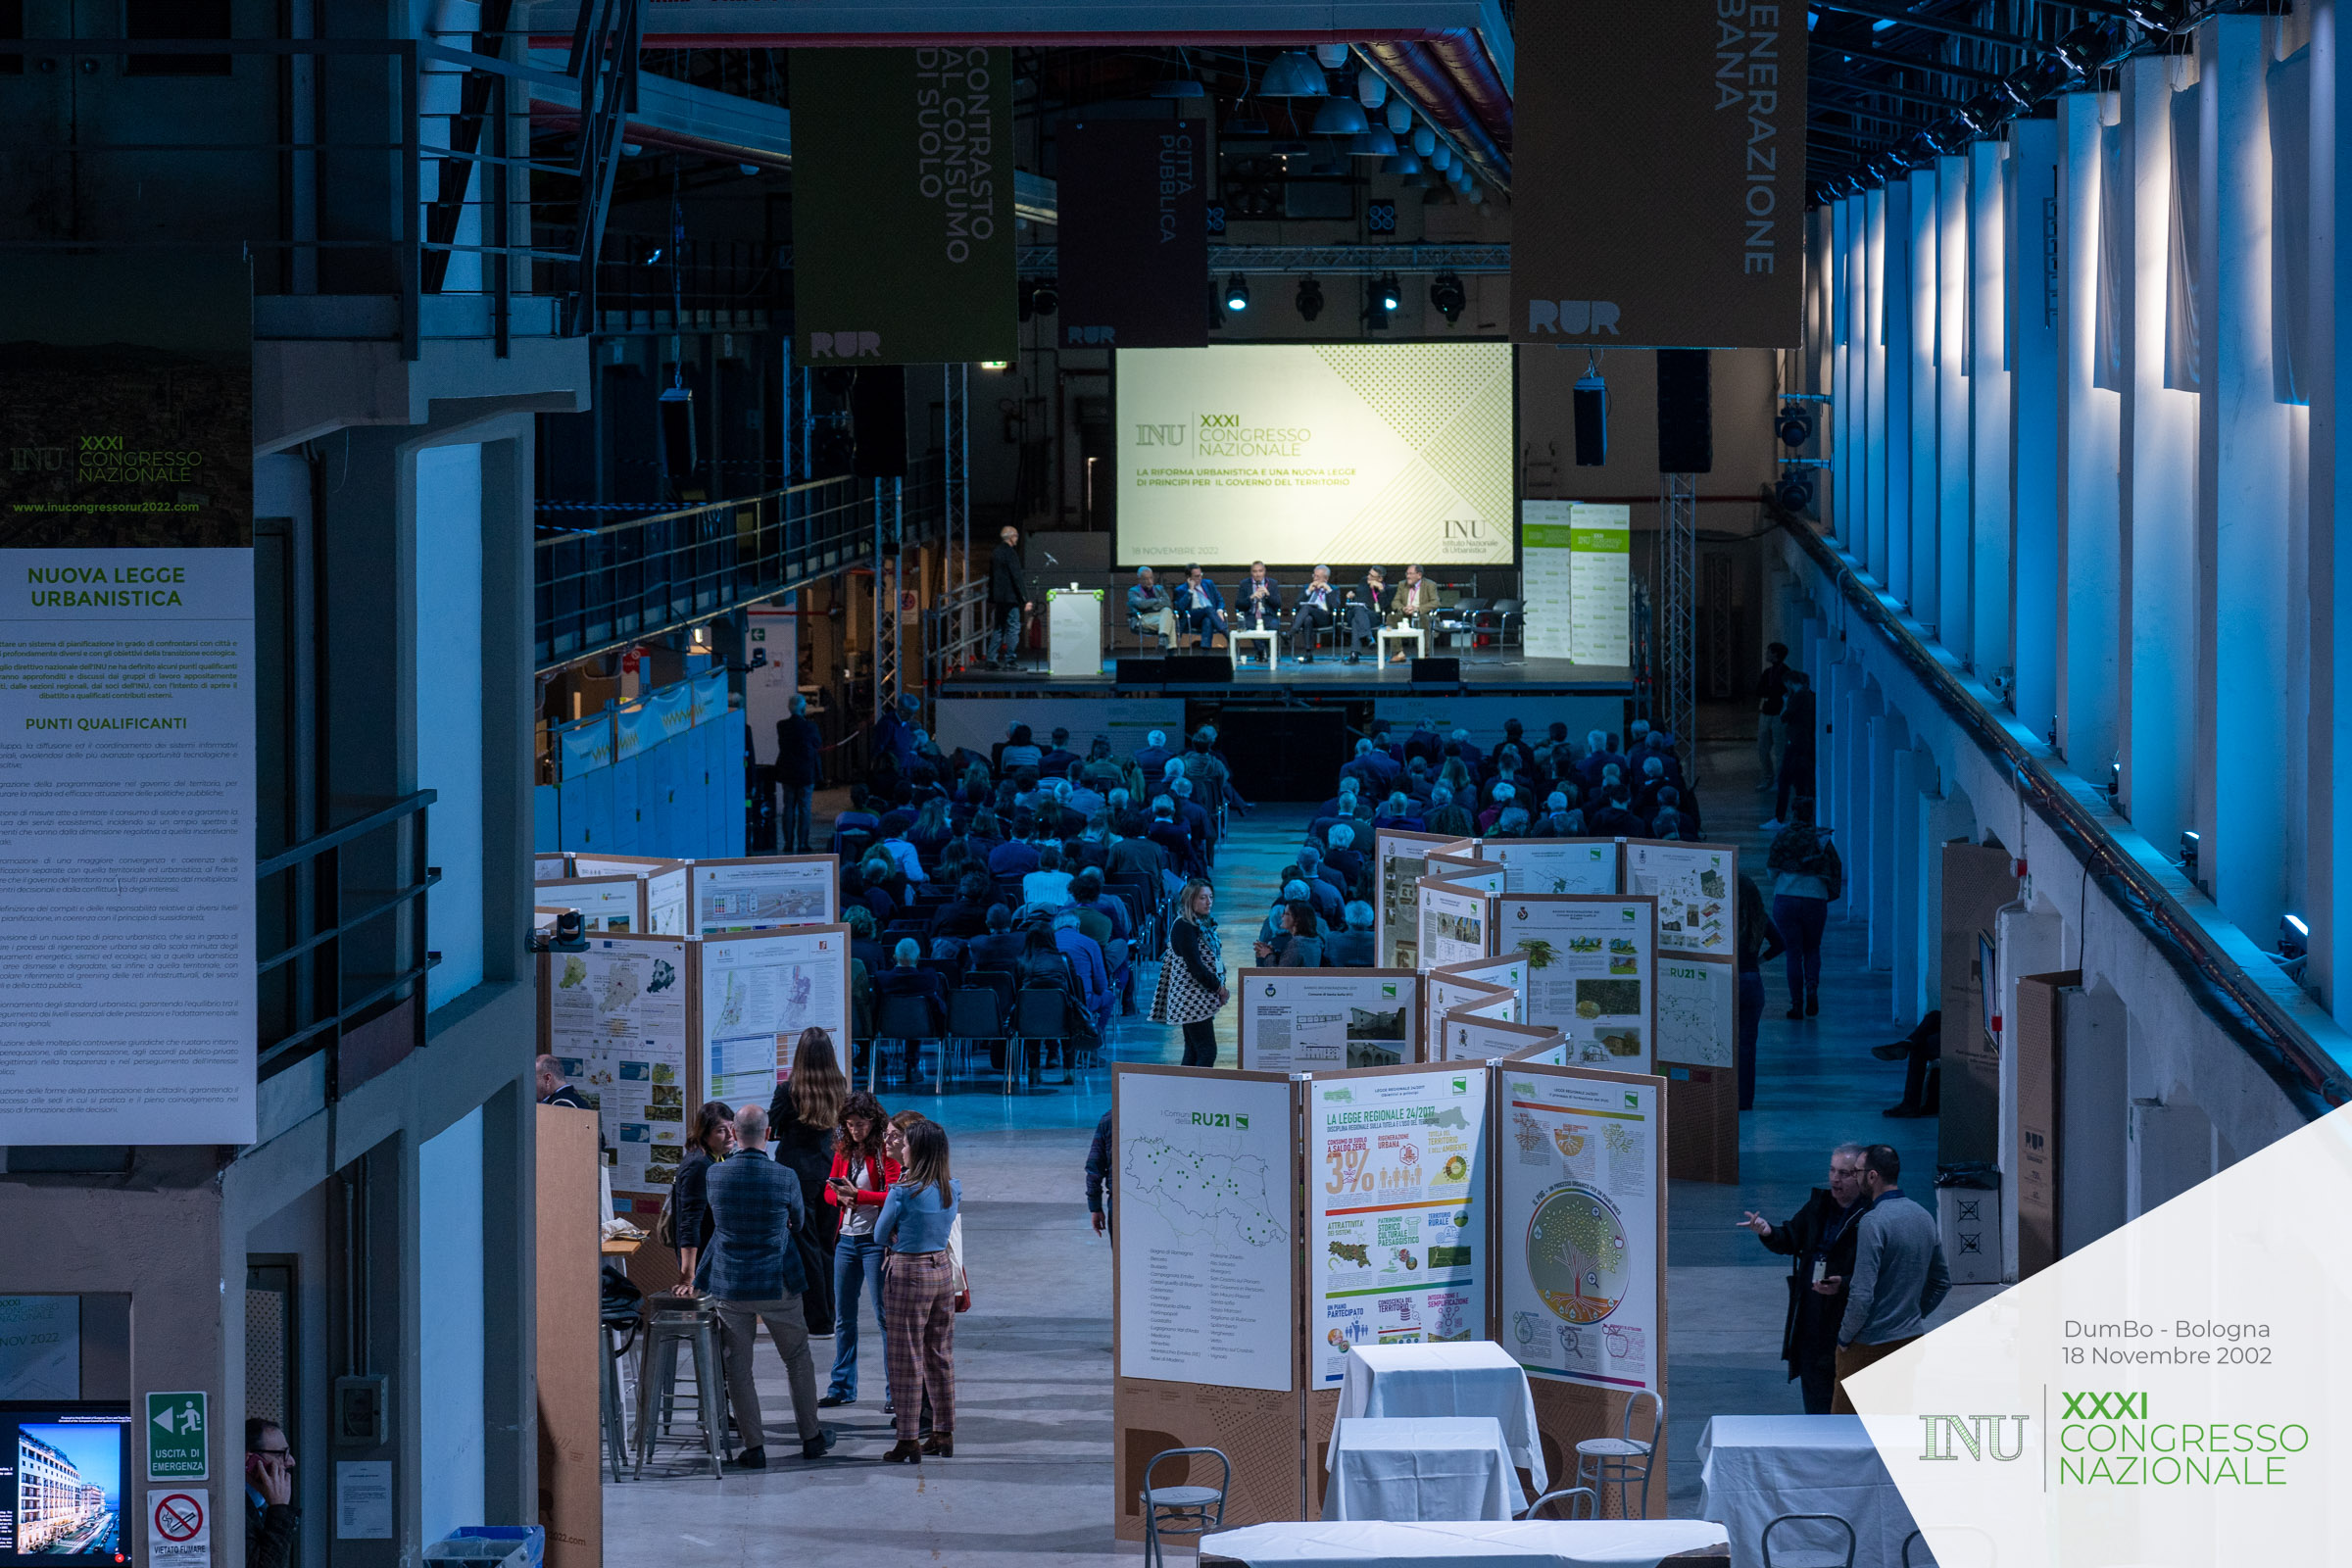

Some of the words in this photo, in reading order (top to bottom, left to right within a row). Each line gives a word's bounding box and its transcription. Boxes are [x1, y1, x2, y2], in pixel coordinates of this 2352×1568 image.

[916, 48, 939, 77] DI
[941, 48, 964, 88] AL
[917, 89, 942, 198] SUOLO
[967, 47, 994, 240] CONTRASTO
[1744, 5, 1779, 274] ENERAZIONE
[1176, 135, 1197, 195] CITTÀ
[943, 97, 969, 263] CONSUMO
[1160, 134, 1176, 244] PUBBLICA
[1529, 300, 1621, 335] RUR
[1068, 325, 1116, 344] RUR
[810, 331, 881, 359] RUR
[1200, 414, 1239, 427] XXXI
[1136, 423, 1186, 446] INU
[1200, 428, 1311, 442] CONGRESSO
[80, 436, 123, 451] XXXI
[1200, 443, 1301, 457] NAZIONALE
[10, 447, 65, 471] INU
[78, 451, 203, 466] CONGRESSO
[78, 467, 192, 482] NAZIONALE
[1327, 467, 1356, 476] LEGGE
[13, 501, 200, 514] www.inucongressorur2022.com
[1443, 520, 1487, 539] INU
[28, 567, 108, 584] NUOVA
[115, 567, 185, 583] LEGGE
[31, 590, 183, 607] URBANISTICA
[25, 718, 73, 730] PUNTI
[77, 717, 187, 733] QUALIFICANTI
[1670, 967, 1695, 979] RU21
[1192, 1111, 1230, 1127] RU21
[1327, 1113, 1337, 1125] LA
[1339, 1111, 1362, 1124] LEGGE
[1363, 1108, 1404, 1122] REGIONALE
[1406, 1105, 1436, 1119] 24/2017
[1325, 1149, 1374, 1195] 3%
[1378, 1223, 1400, 1232] STORICO
[1428, 1218, 1448, 1227] RURALE
[1378, 1230, 1407, 1240] CULTURALE
[1327, 1308, 1363, 1318] PARTECIPATO
[30, 1333, 60, 1345] 2022
[155, 1449, 186, 1458] USCITA
[191, 1448, 200, 1458] DI
[152, 1461, 204, 1472] EMERGENZA
[154, 1545, 178, 1555] VIETATO
[180, 1544, 206, 1554] FUMARE
